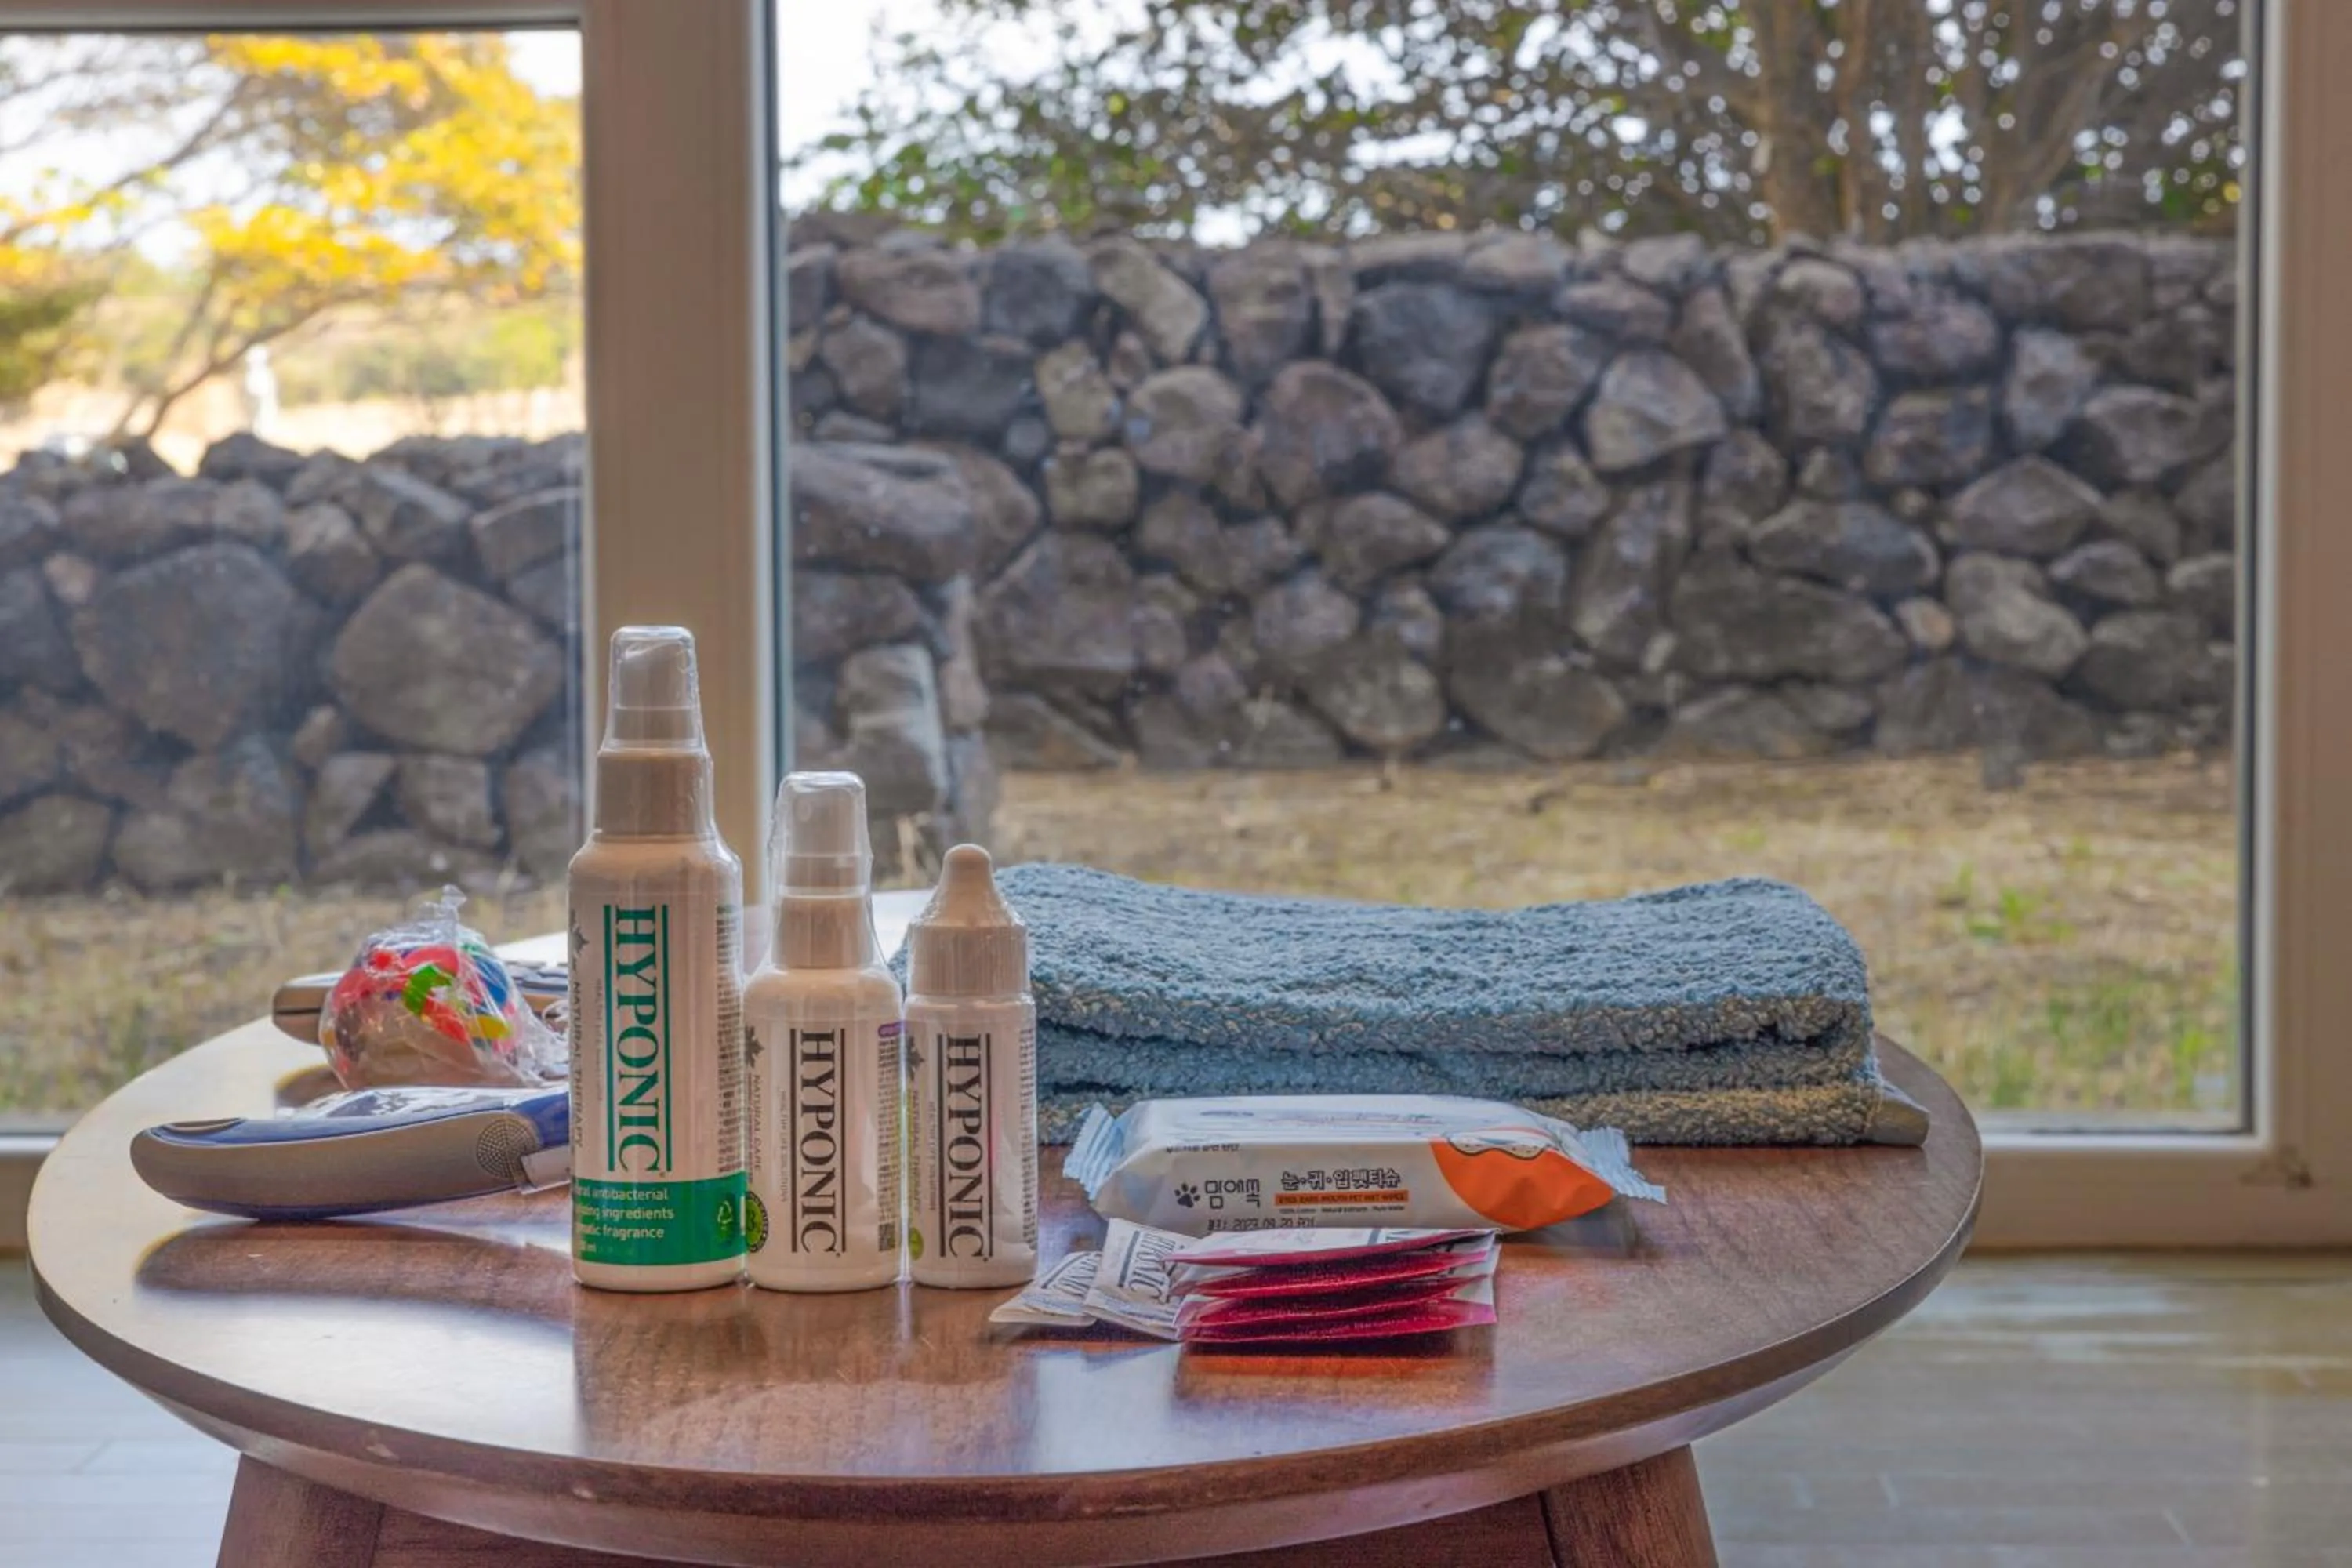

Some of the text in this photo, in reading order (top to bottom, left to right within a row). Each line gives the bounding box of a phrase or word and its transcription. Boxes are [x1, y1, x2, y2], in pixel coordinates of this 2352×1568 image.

[615, 905, 661, 1173] HYPONIC
[592, 1188, 669, 1201] antibacterial
[800, 1028, 837, 1254] HYPONIC
[947, 1033, 985, 1261] HYPONIC
[601, 1206, 675, 1222] ingredients
[602, 1223, 665, 1241] fragrance
